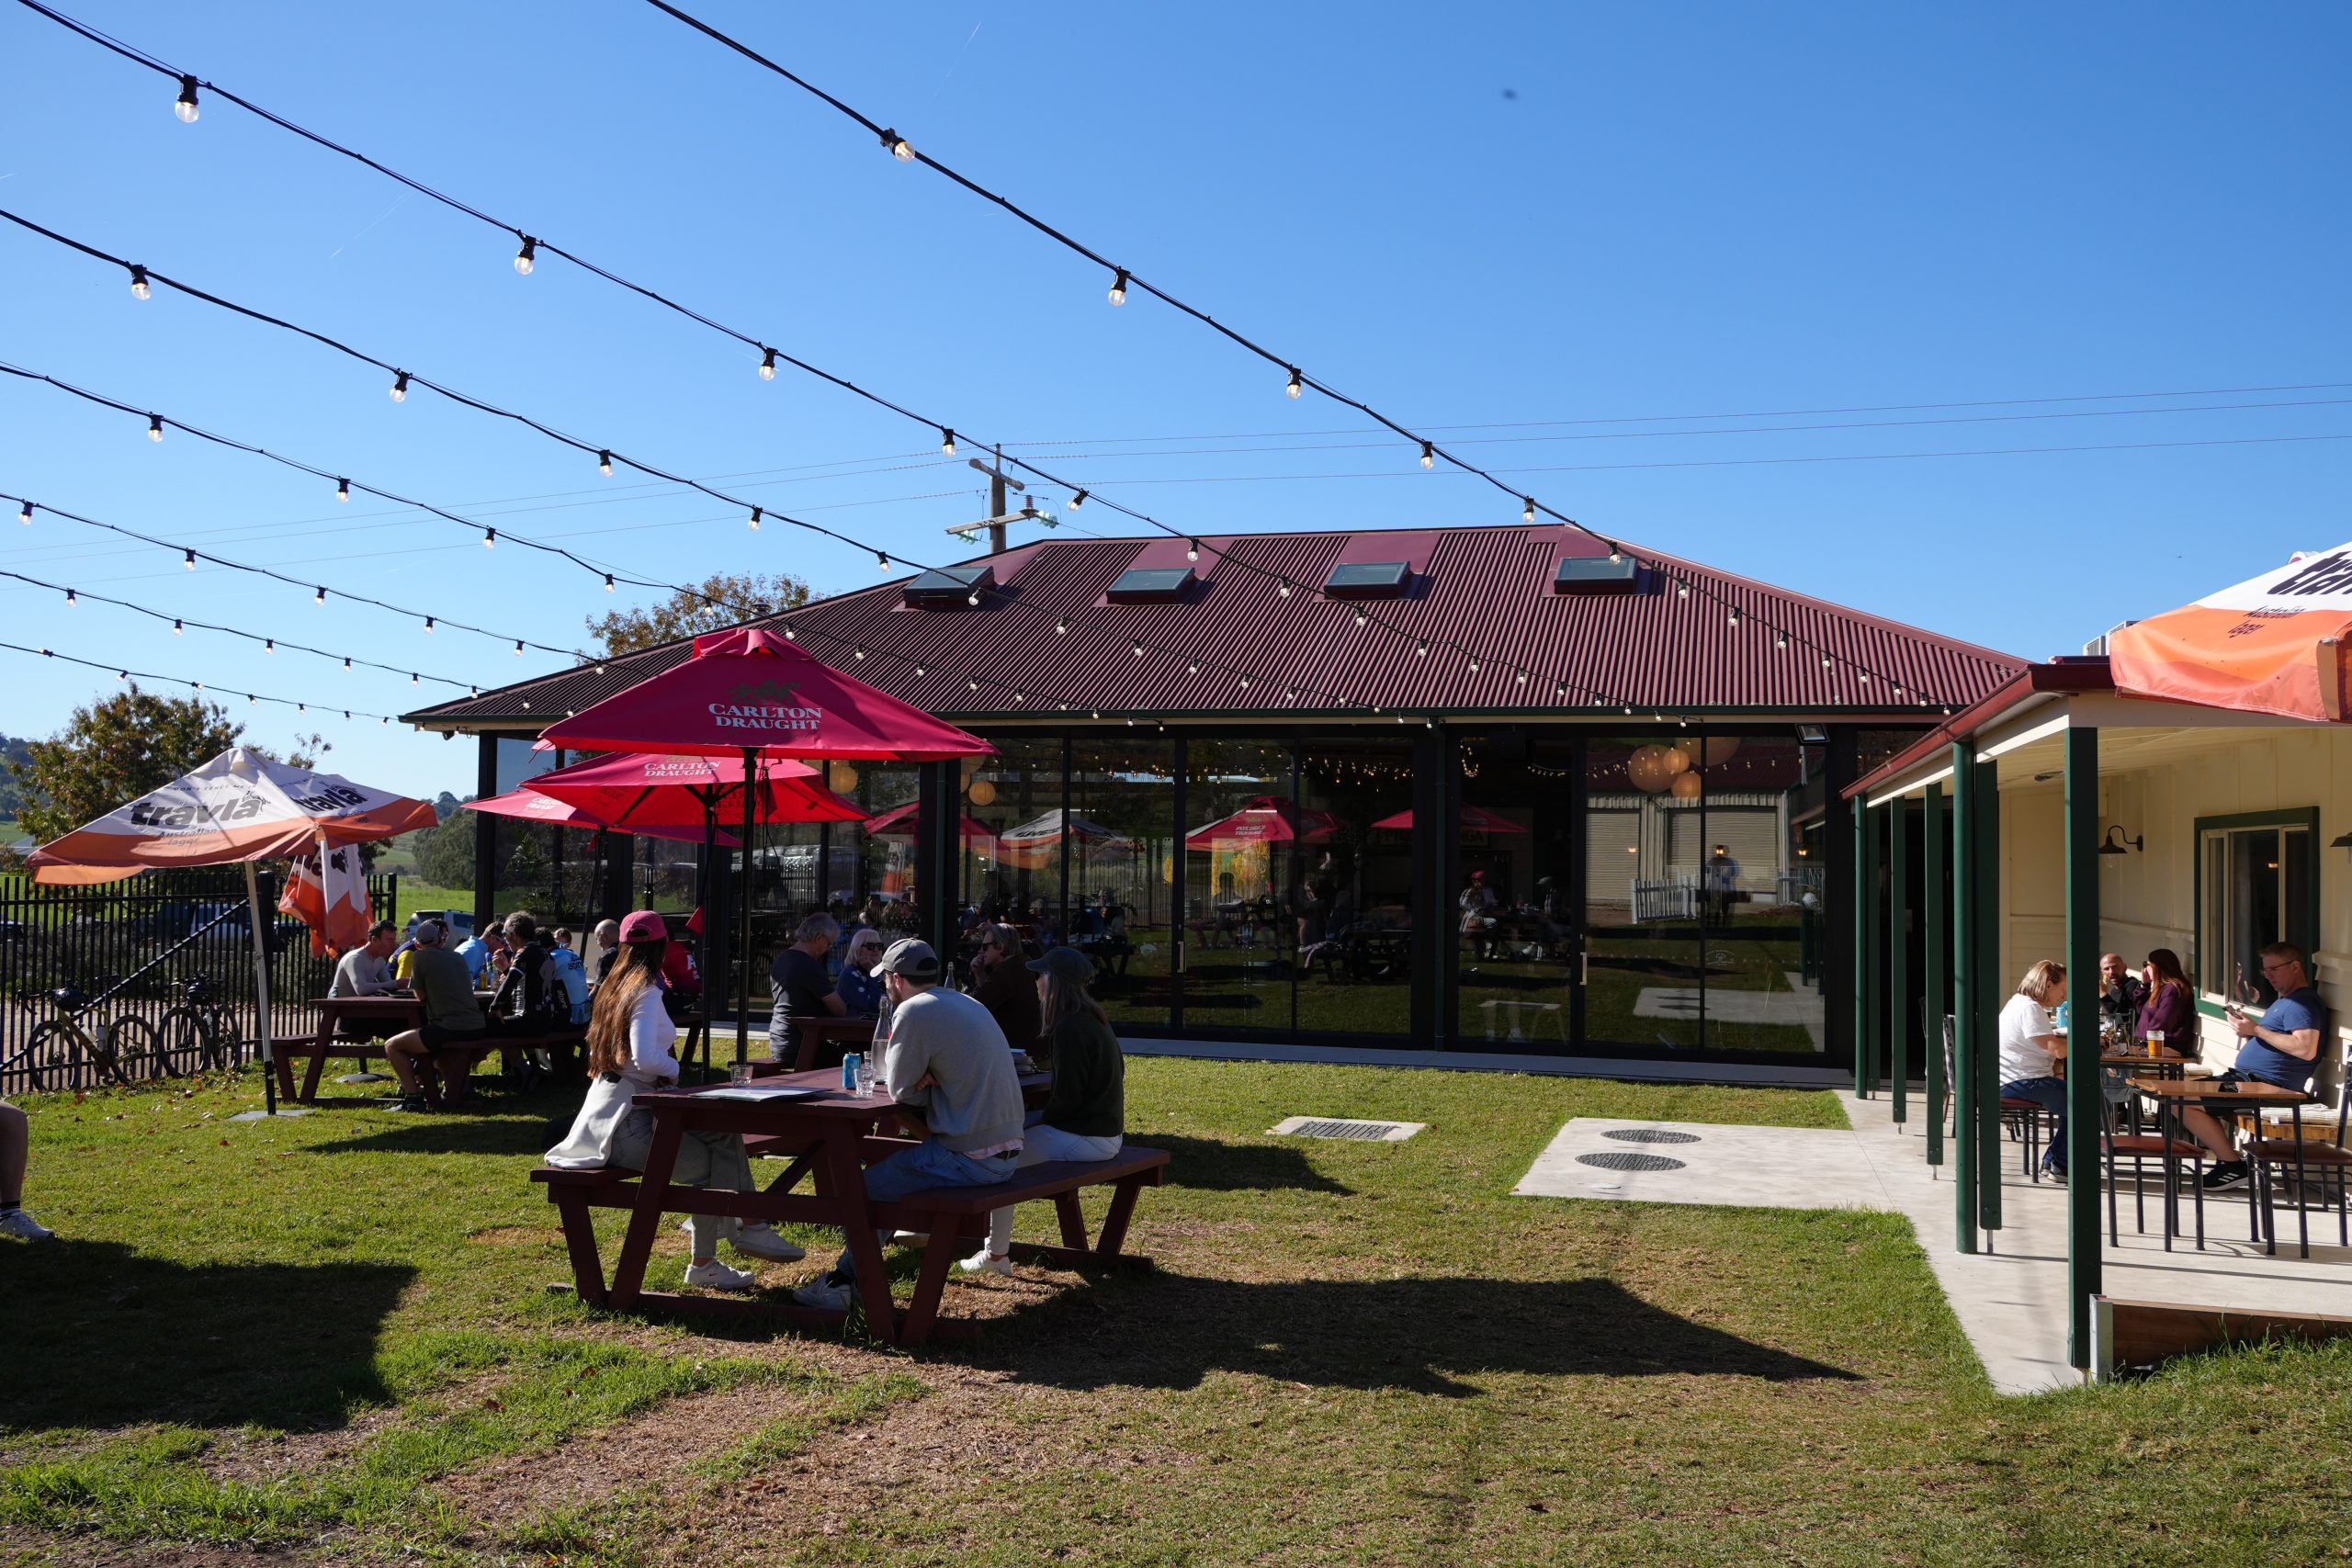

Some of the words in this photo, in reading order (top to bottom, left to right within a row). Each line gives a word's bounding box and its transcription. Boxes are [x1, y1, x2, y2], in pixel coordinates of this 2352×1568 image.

[708, 703, 823, 718] CARLTON
[715, 716, 820, 729] DRAUGHT
[644, 761, 721, 771] CARLTON
[644, 768, 717, 777] DRAUGHT
[291, 786, 368, 812] travla
[131, 798, 261, 825] travla
[157, 829, 217, 838] Australian
